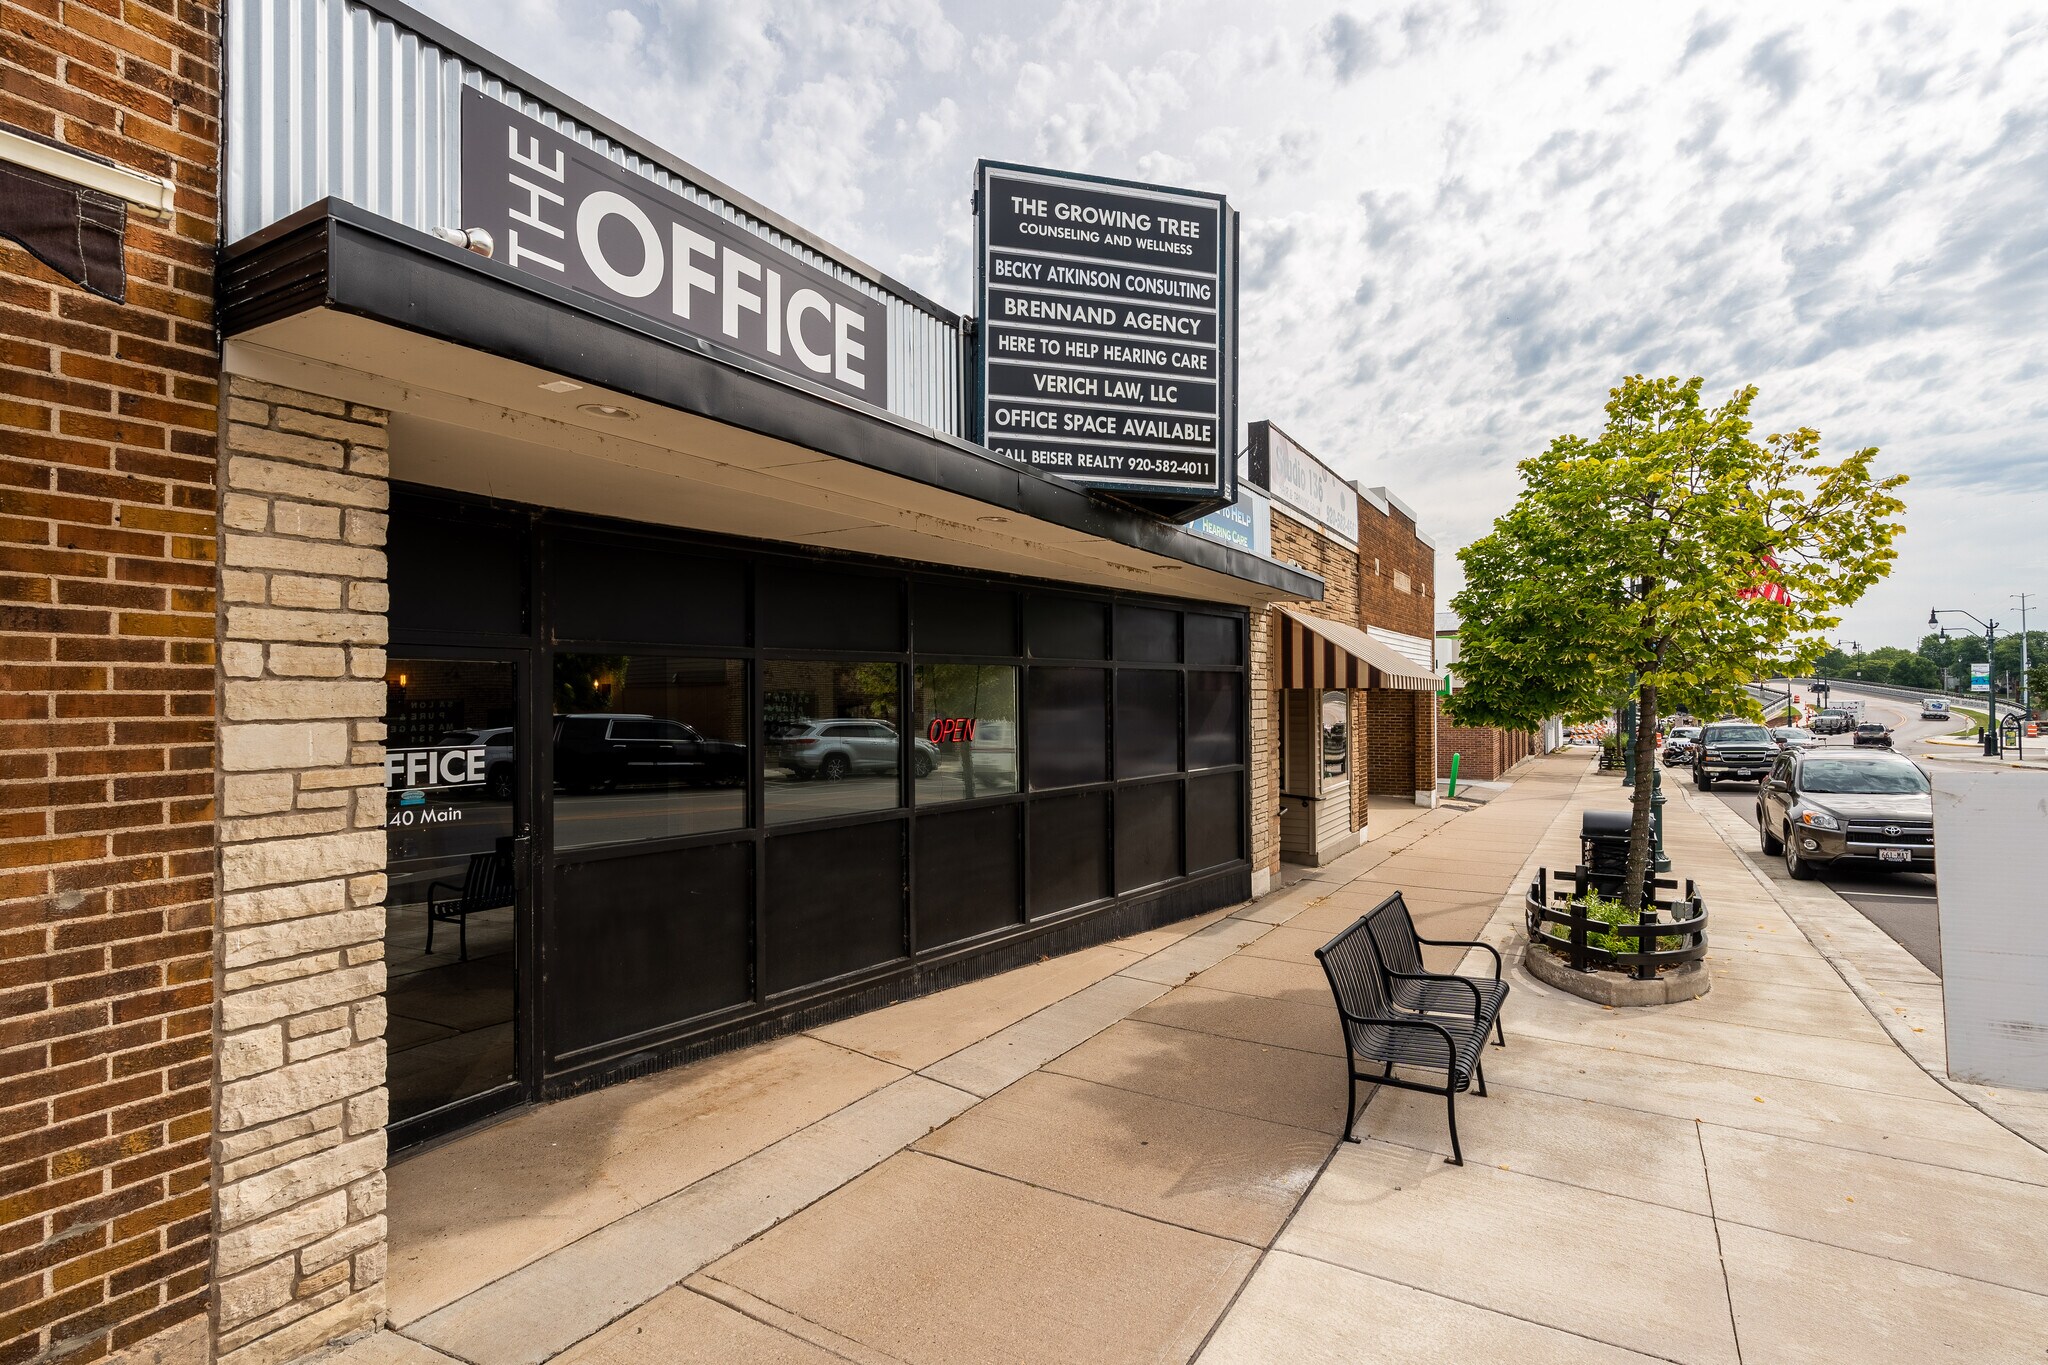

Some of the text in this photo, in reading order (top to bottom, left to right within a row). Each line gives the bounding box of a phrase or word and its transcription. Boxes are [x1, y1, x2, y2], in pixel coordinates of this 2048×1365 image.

[508, 125, 565, 273] THE
[1011, 196, 1200, 239] THE GROWING TREE
[1019, 222, 1193, 255] COUNSELING AND WELLNESS
[576, 190, 866, 390] OFFICE
[995, 259, 1211, 300] BECKY ATKINSON CONSULTING
[1004, 297, 1201, 335] BRENNAND AGENCY
[998, 335, 1208, 370] HERE TO HELP HEARING CARE
[1033, 373, 1178, 403] VERICH LAW, LLC
[994, 408, 1211, 442] OFFICE SPACE AVAILABLE
[1032, 450, 1073, 466] BEISER
[1077, 454, 1124, 471] REALTY
[1128, 457, 1209, 475] 920-582-4011
[1276, 445, 1323, 502] Studio 136
[1202, 517, 1248, 548] HEARING CARE
[1231, 505, 1251, 527] HELP
[929, 717, 976, 743] OPEN
[384, 807, 462, 828] 40 Main
